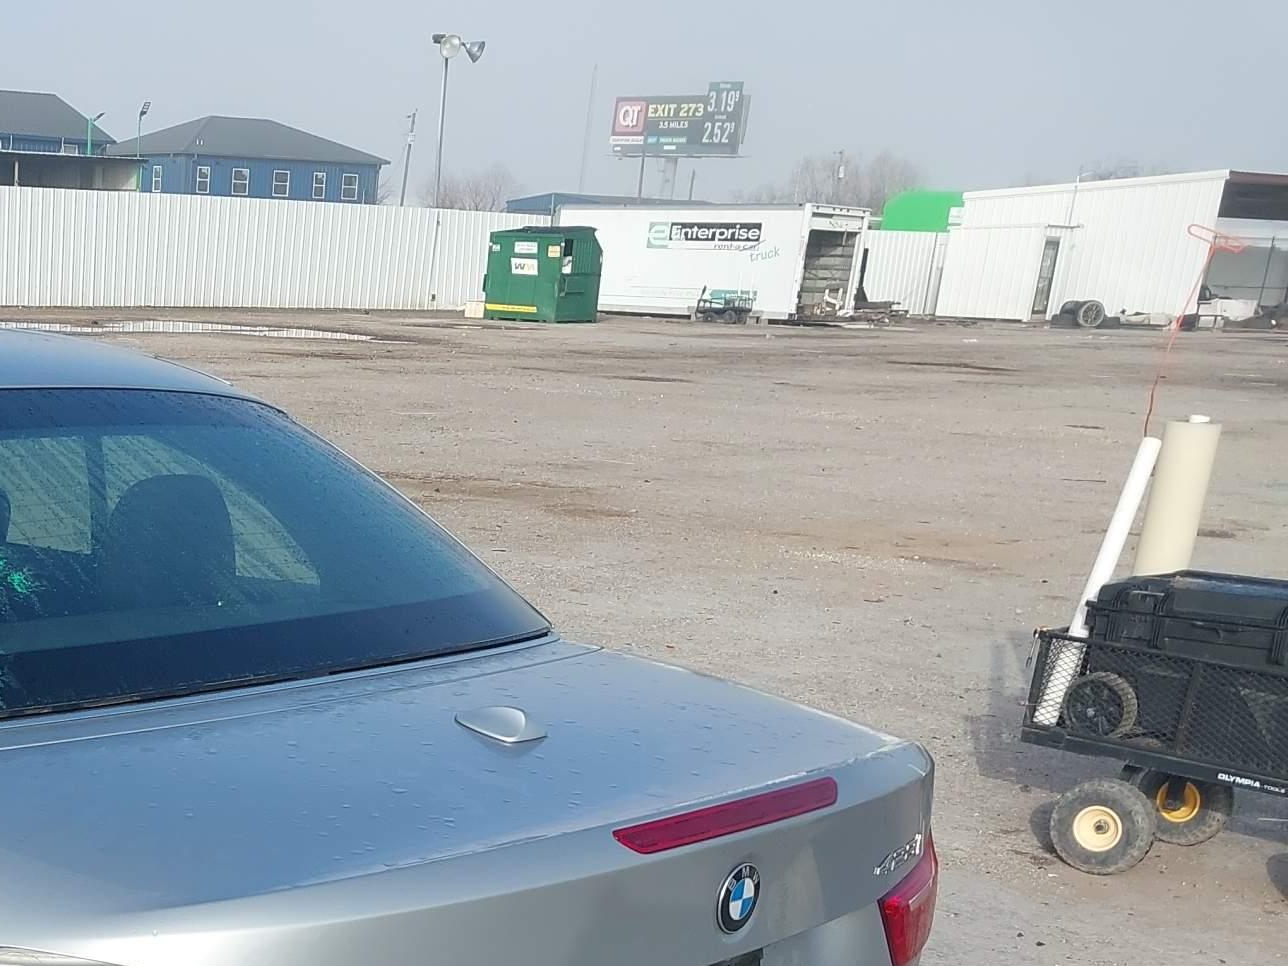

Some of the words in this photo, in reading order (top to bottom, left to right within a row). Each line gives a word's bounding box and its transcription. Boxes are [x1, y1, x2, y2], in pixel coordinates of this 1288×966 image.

[619, 105, 641, 128] QT
[647, 104, 679, 117] EXIT
[679, 103, 704, 117] 273
[669, 120, 689, 128] MILES
[671, 225, 760, 241] Enterprise
[750, 246, 780, 262] truck
[1217, 772, 1261, 788] OLYMPIA
